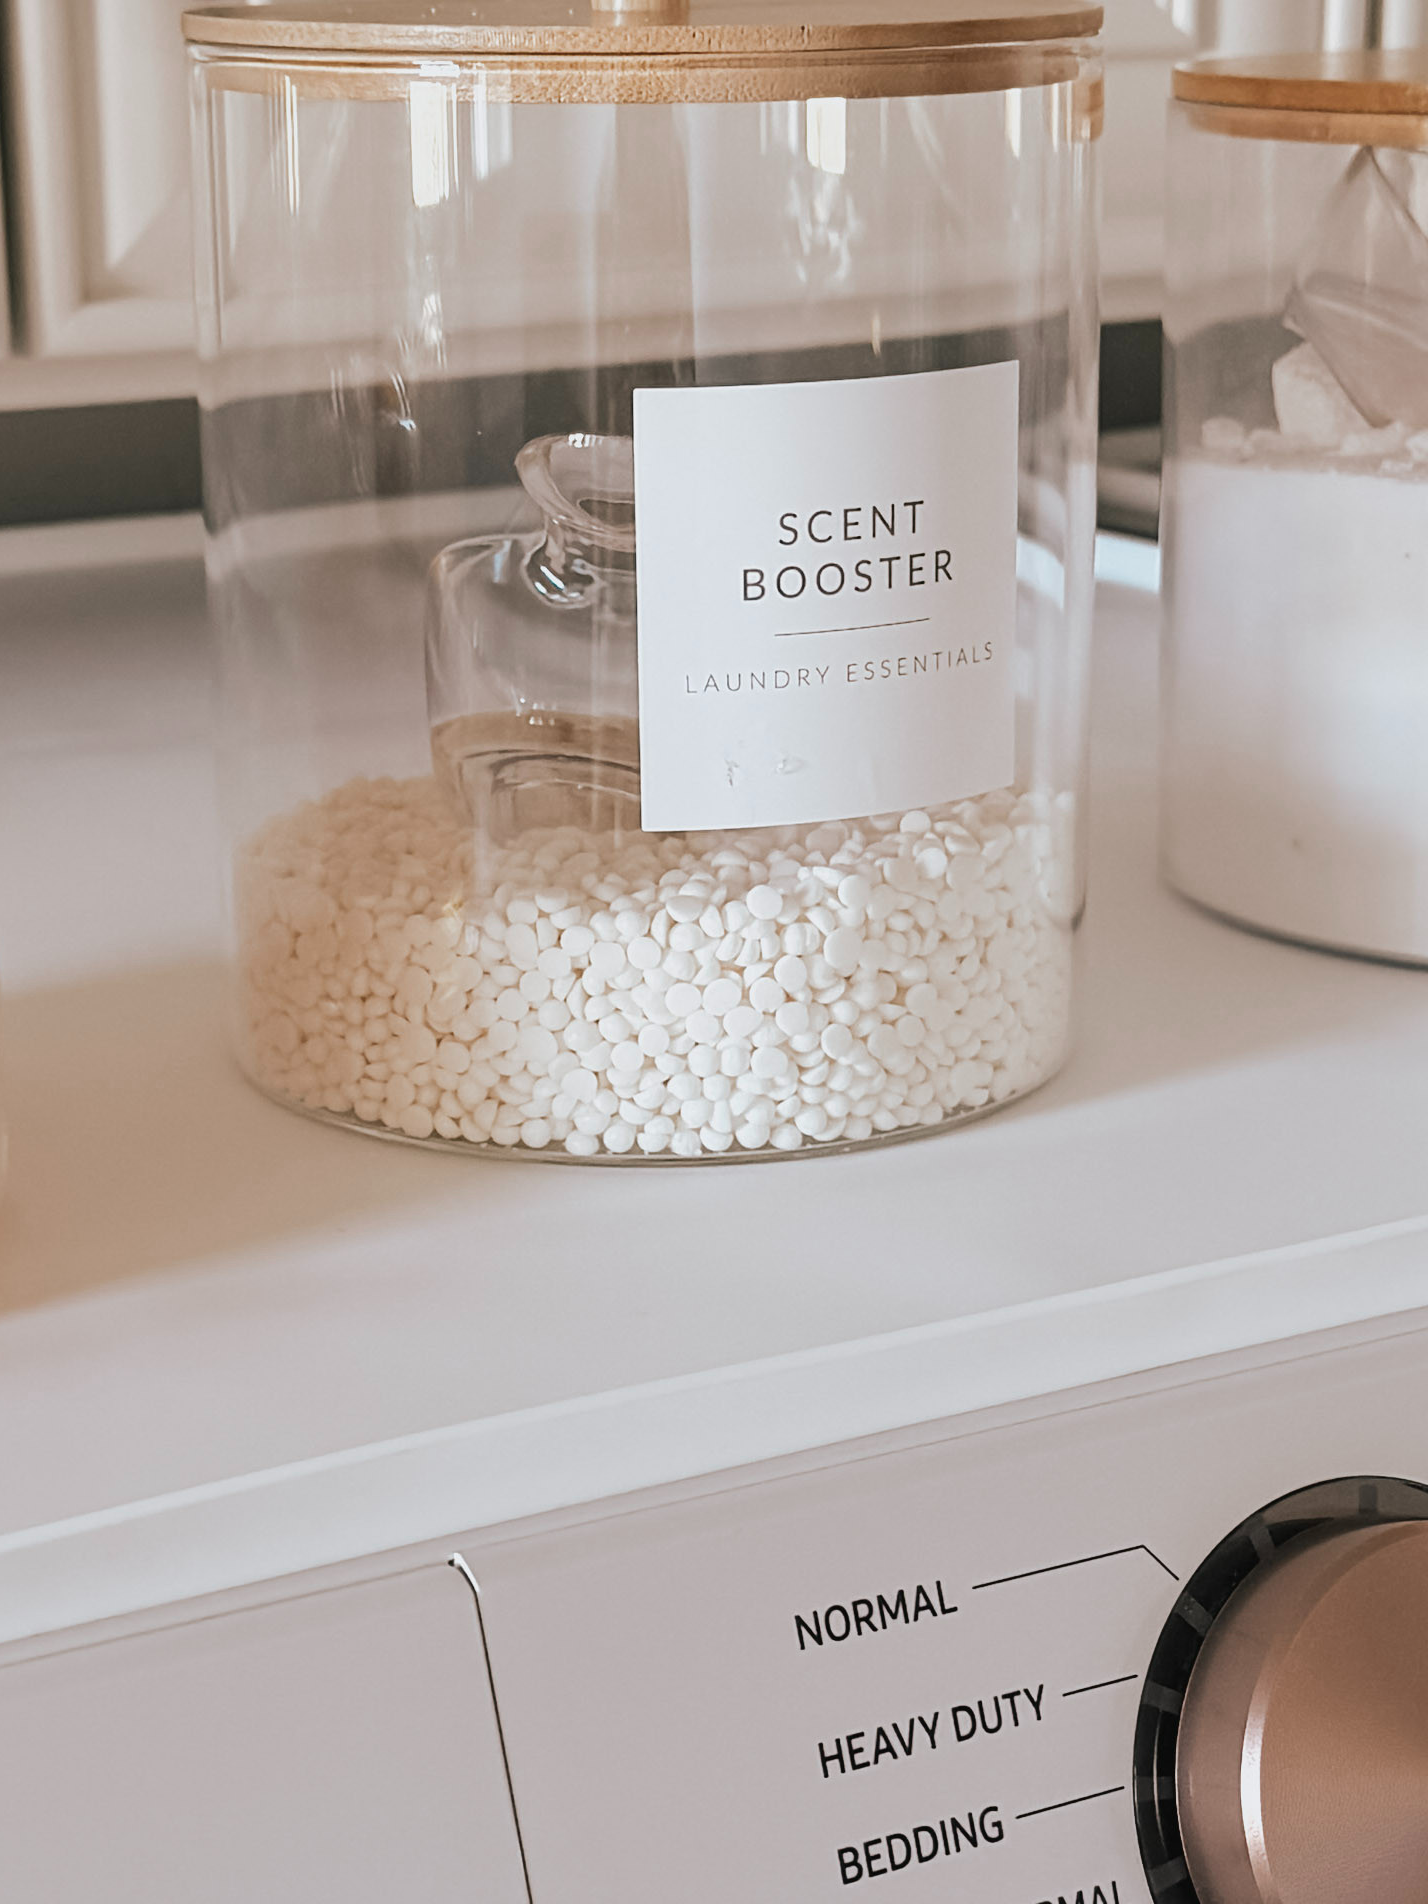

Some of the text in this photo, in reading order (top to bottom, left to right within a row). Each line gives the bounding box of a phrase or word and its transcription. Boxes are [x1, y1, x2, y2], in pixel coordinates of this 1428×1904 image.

[778, 499, 925, 546] SCENT
[742, 548, 954, 602] BOOSTER
[686, 640, 994, 695] LAUNDRY ESSENTIALS
[793, 1579, 959, 1651] NORMAL
[817, 1683, 1045, 1779] HEAVY DUTY
[836, 1805, 1005, 1885] BEDDING
